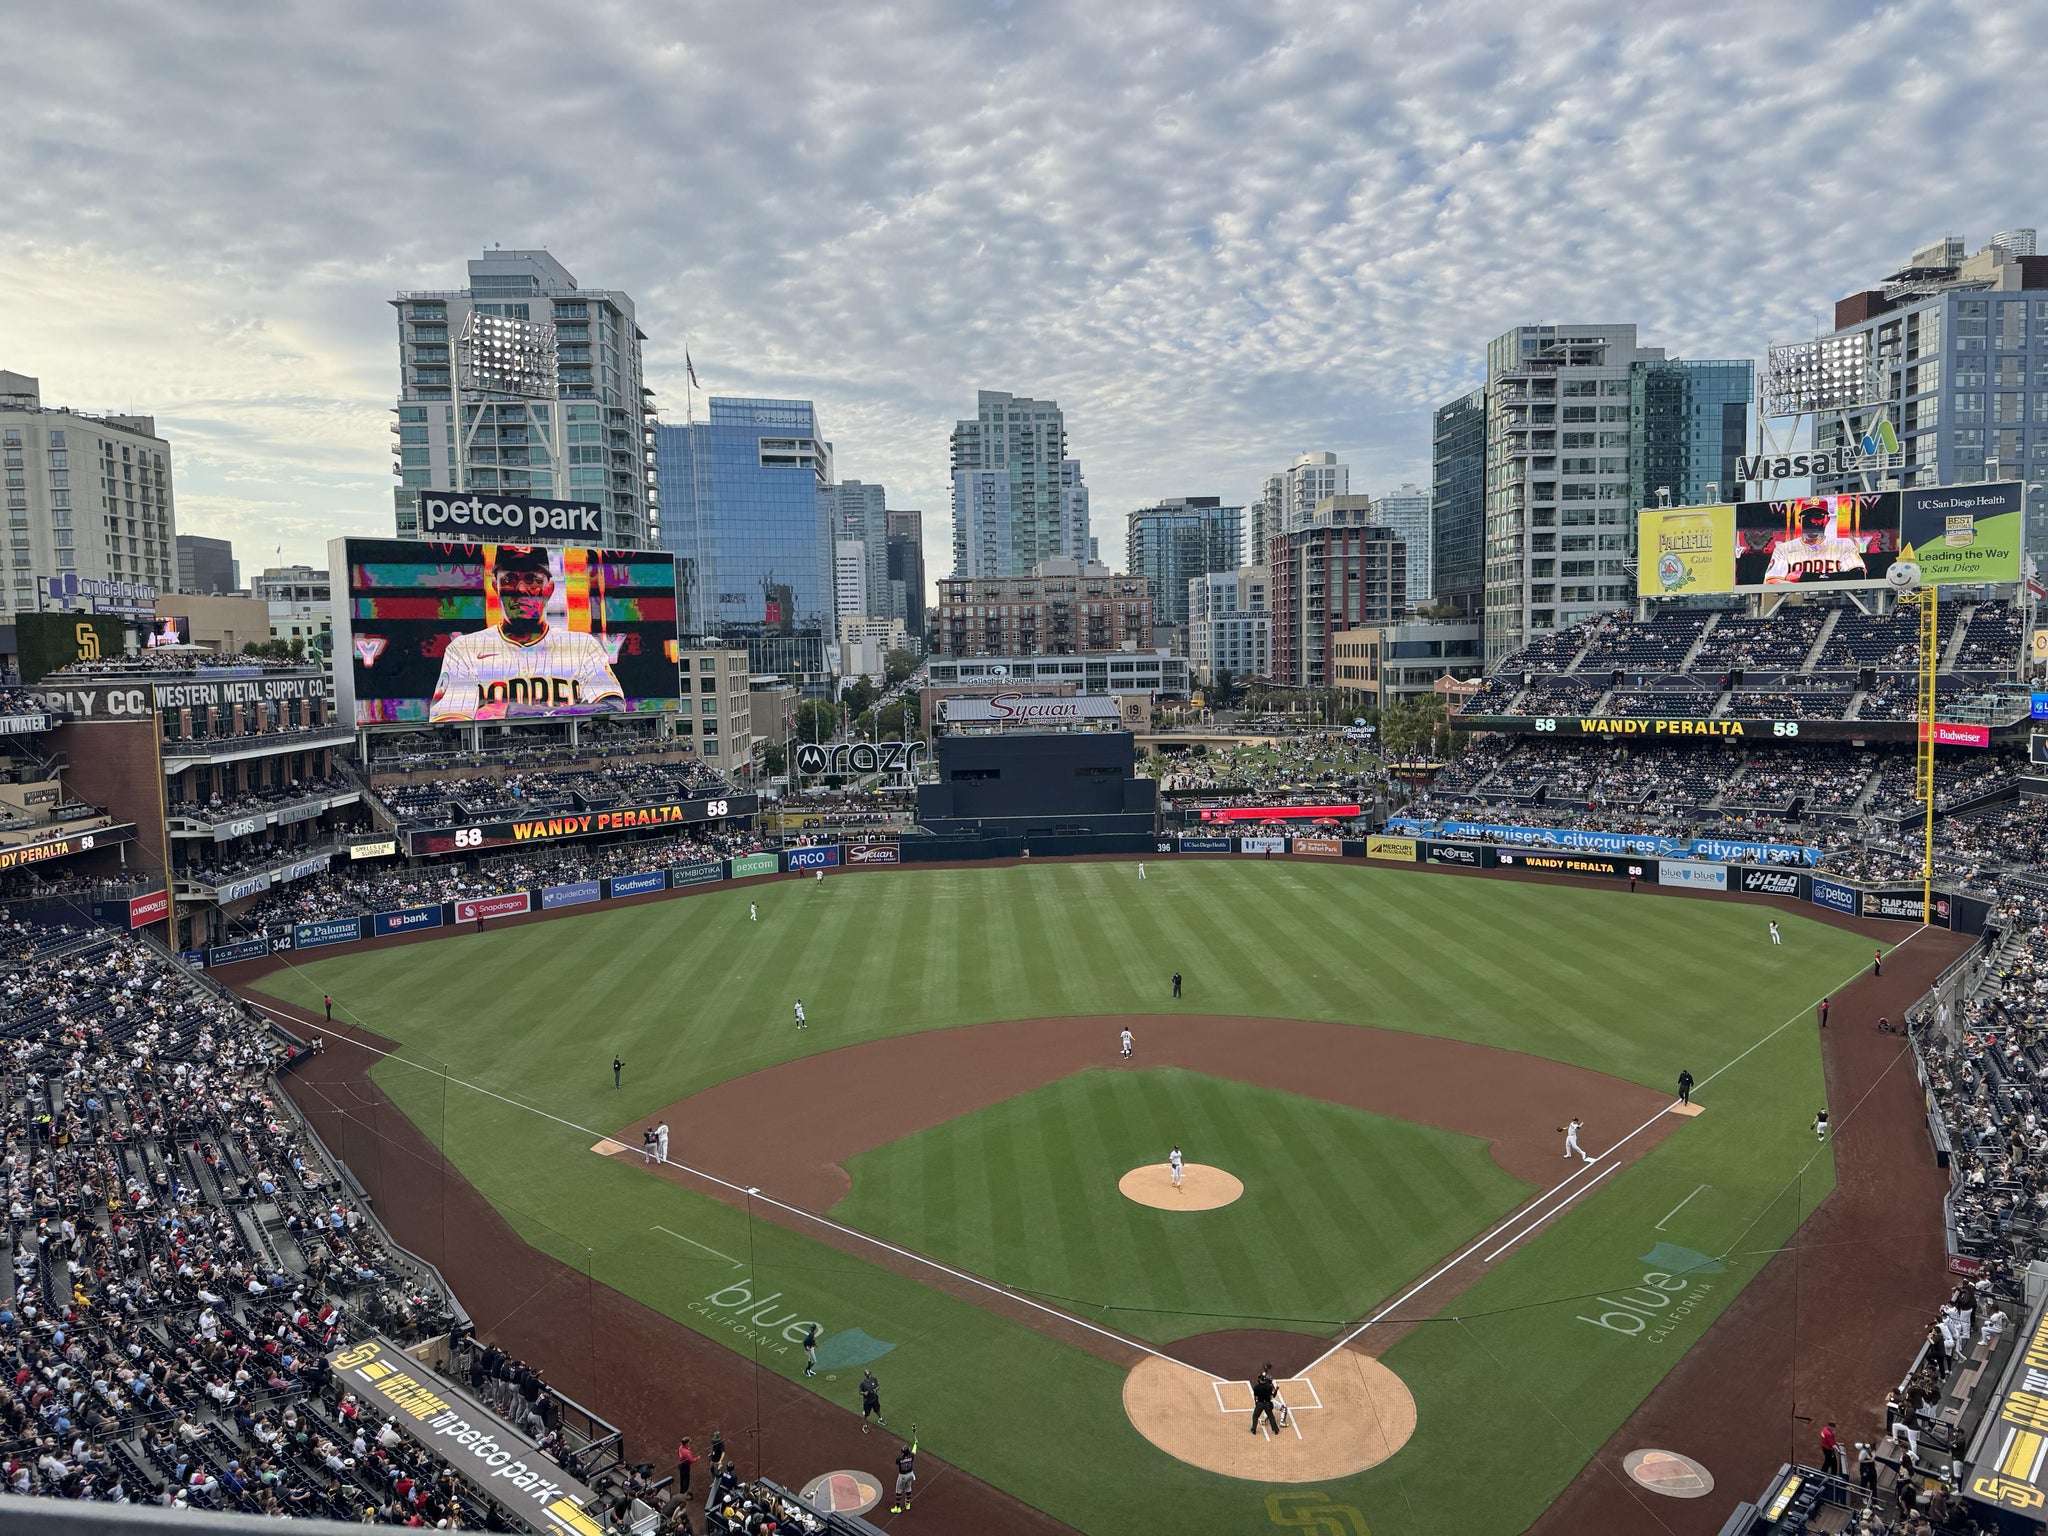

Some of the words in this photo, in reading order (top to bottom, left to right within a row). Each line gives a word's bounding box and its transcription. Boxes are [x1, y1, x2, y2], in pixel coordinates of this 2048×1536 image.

[1738, 446, 1849, 481] Viasat
[1917, 501, 1931, 509] UC
[1932, 500, 1949, 508] San
[1950, 498, 1975, 508] Diego
[1976, 496, 2006, 505] Health
[427, 496, 524, 529] petco
[529, 506, 599, 535] park
[1948, 516, 1971, 524] BEST
[1918, 552, 1962, 561] Leading
[1965, 550, 1983, 559] the
[1985, 549, 2009, 560] Way
[1931, 565, 1949, 573] San
[1953, 564, 1980, 574] Diego
[80, 578, 156, 600] QuidelOrtho
[967, 677, 1003, 685] Gallagher
[1004, 677, 1032, 685] Square
[154, 684, 218, 707] WESTERN
[224, 682, 263, 703] METAL
[265, 680, 305, 700] SUPPLY
[309, 679, 326, 697] CO.
[107, 690, 153, 715] CO.
[989, 692, 1079, 725] Sycuan
[1129, 705, 1139, 715] 19
[1342, 726, 1376, 734] Gallagher
[1535, 719, 1556, 731] 58
[1580, 719, 1650, 733] WANDY
[1655, 720, 1745, 735] PERALTA
[1773, 722, 1799, 737] 58
[1940, 730, 1980, 742] Budweiser
[830, 741, 926, 773] razr
[454, 828, 482, 848] 58
[512, 815, 591, 840] WANDY
[597, 806, 684, 830] PERALTA
[707, 800, 728, 817] 58
[20, 841, 69, 864] PERALTA
[81, 836, 94, 849] 58
[850, 846, 894, 863] Sycuan
[1383, 843, 1413, 851] MERCURY
[791, 852, 825, 866] ARCO
[1501, 855, 1513, 864] 58
[1525, 857, 1563, 869] WANDY
[1566, 861, 1615, 873] PERALTA
[1628, 866, 1642, 876] 58
[675, 866, 721, 879] CYMBIOTIKA
[1661, 868, 1682, 877] blue
[1694, 870, 1715, 880] blue
[229, 880, 263, 900] Canel's
[615, 878, 656, 891] Southwest
[1760, 884, 1795, 894] POWER
[556, 887, 598, 900] QuidelOrtho
[1825, 888, 1853, 904] petco
[479, 900, 522, 912] Snapdragon
[1882, 899, 1901, 908] SLAP
[403, 912, 428, 924] bank
[1881, 906, 1906, 915] CHEESE
[1907, 909, 1917, 917] ON
[314, 923, 357, 937] Palomar
[272, 936, 291, 951] 342
[705, 1279, 824, 1344] blue
[1576, 1272, 1688, 1337] blue
[1647, 1283, 1713, 1343] CALIFORNIA
[687, 1302, 788, 1355] CALIFORNIA
[374, 1372, 451, 1421] WELCOME
[435, 1420, 512, 1467] petco
[491, 1460, 564, 1505] park
